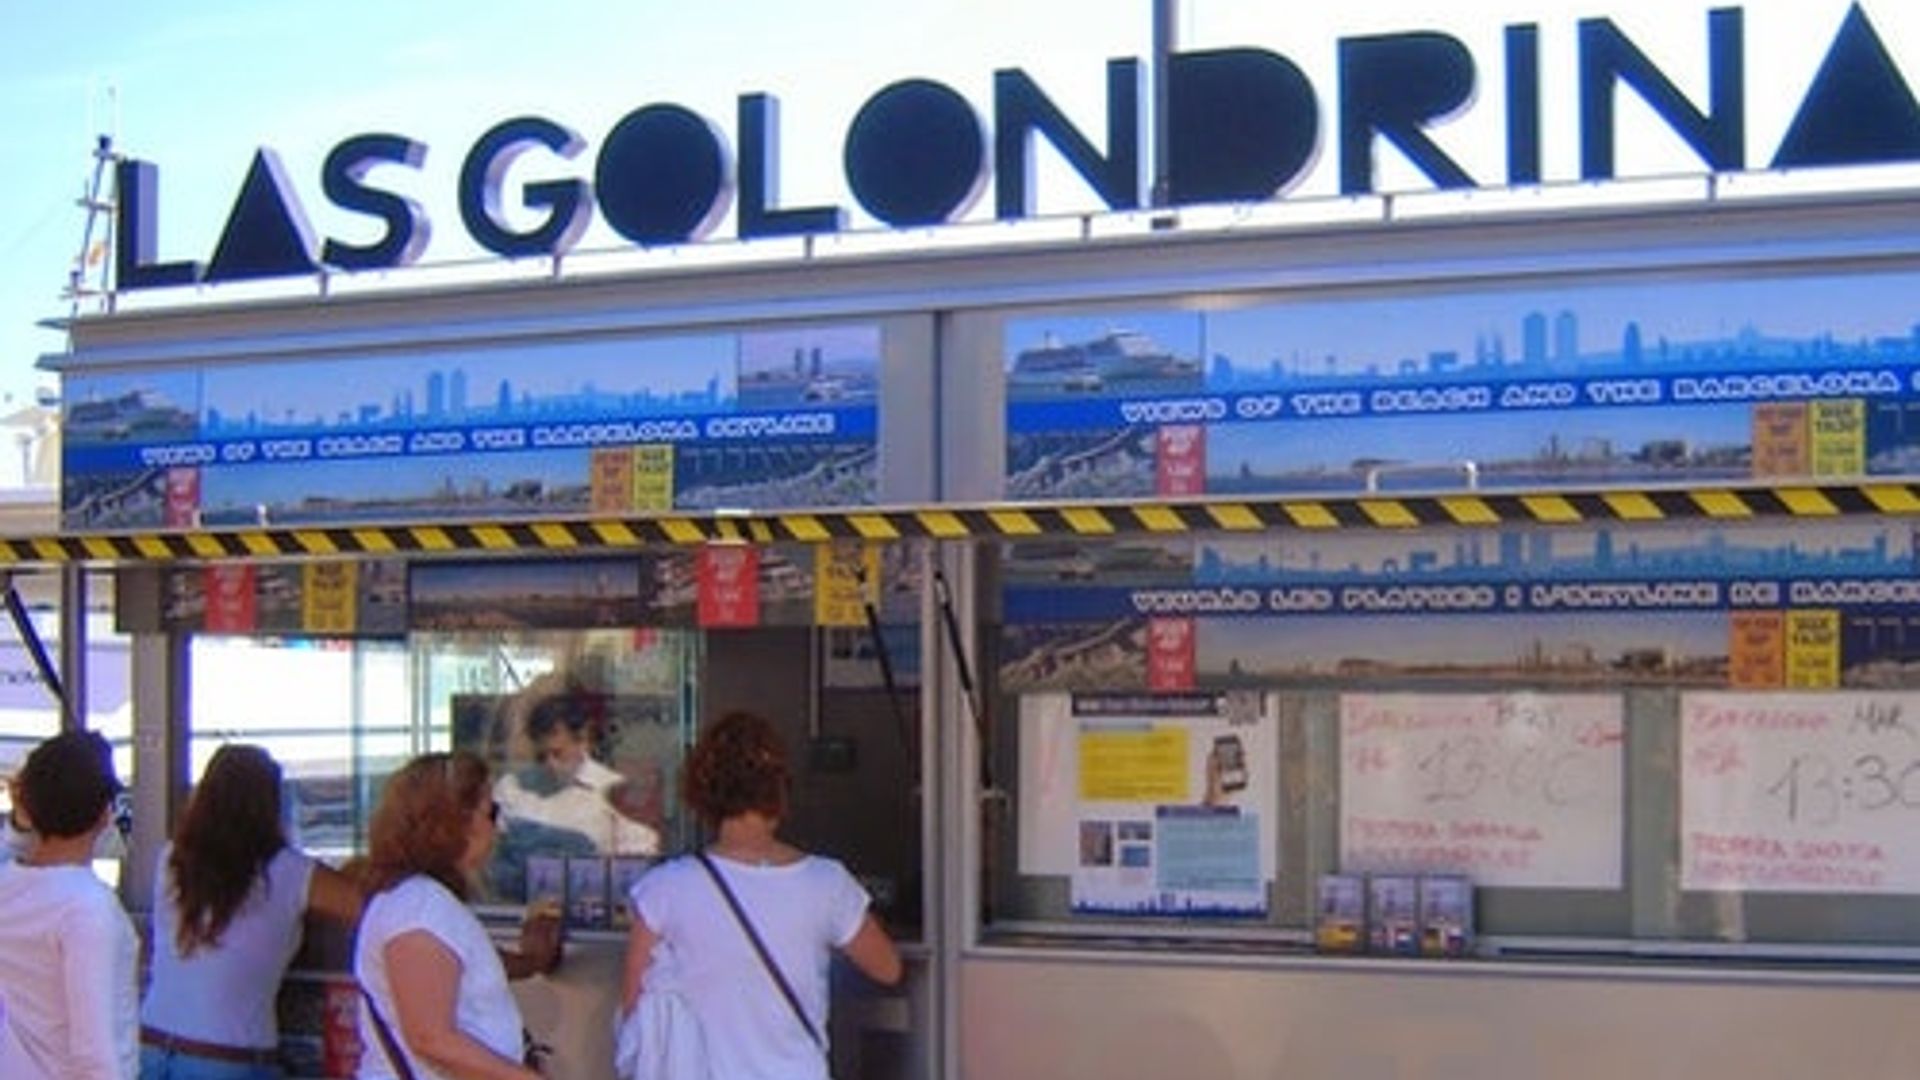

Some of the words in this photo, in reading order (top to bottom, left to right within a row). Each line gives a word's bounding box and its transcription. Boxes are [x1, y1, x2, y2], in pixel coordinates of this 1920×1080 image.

[116, 132, 430, 290] LAS
[1121, 399, 1226, 422] VIEWS
[1236, 396, 1282, 416] OF
[1291, 393, 1361, 414] THE
[1371, 386, 1490, 411] BEACH
[1502, 382, 1576, 406] AND
[1586, 379, 1661, 401] THE
[1673, 371, 1900, 399] BARCELONA
[222, 441, 256, 461] OF
[262, 438, 311, 459] THE
[410, 431, 464, 451] AND
[471, 428, 526, 447] THE
[533, 419, 698, 446] BARCELONA
[706, 412, 835, 437] SKYLINE
[1270, 586, 1332, 609] LES
[1342, 585, 1494, 608] PLATGES
[1730, 581, 1779, 603] DE
